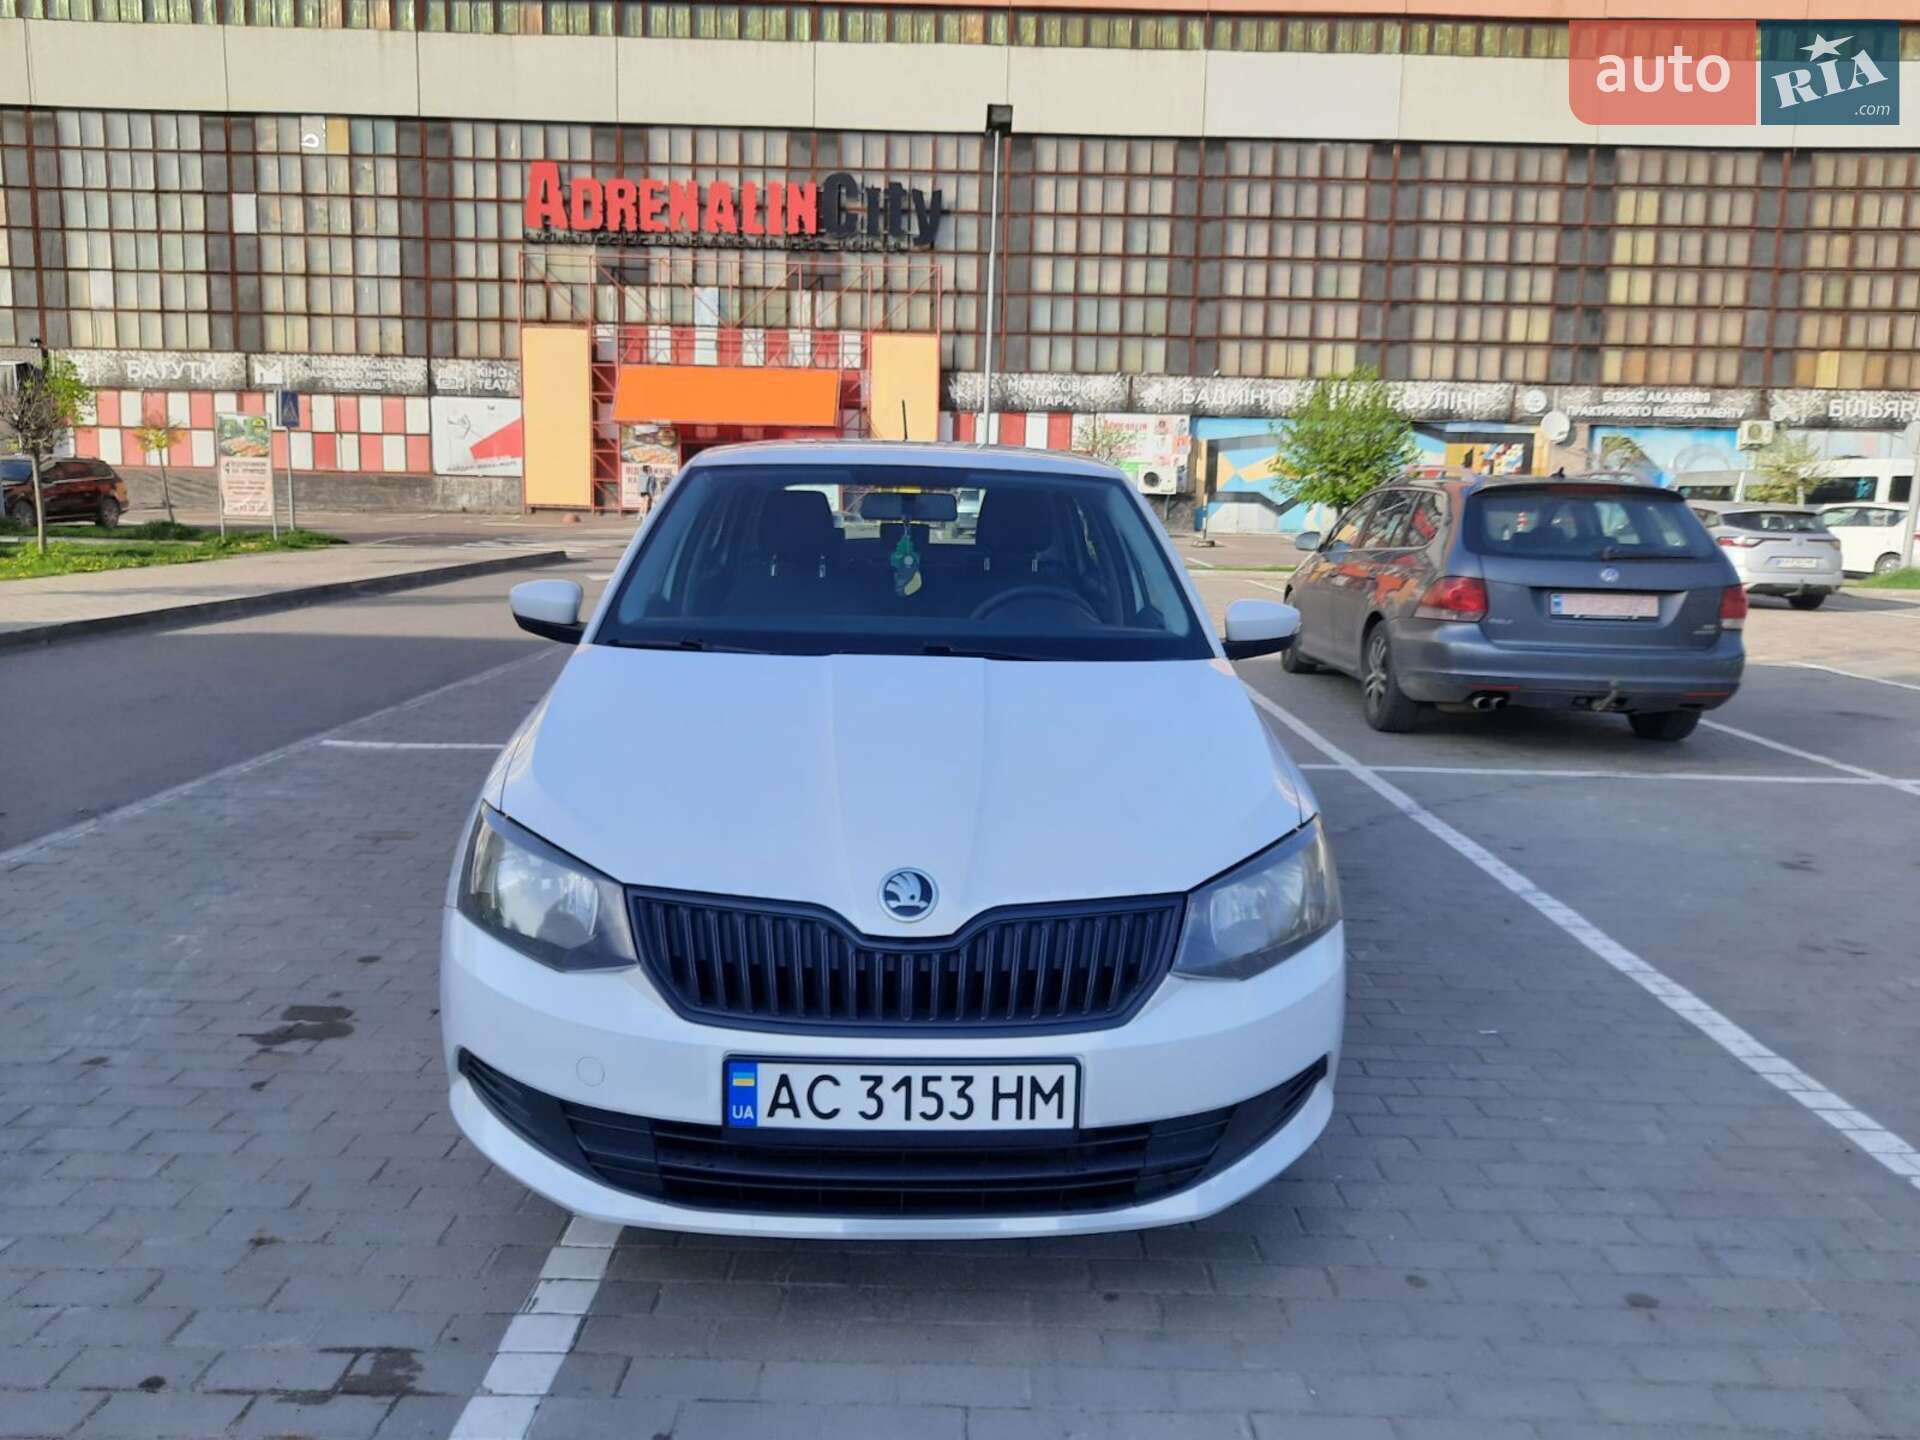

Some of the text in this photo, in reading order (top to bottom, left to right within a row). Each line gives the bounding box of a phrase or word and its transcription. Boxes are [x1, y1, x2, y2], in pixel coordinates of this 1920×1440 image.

[732, 1105, 755, 1121] UA
[766, 1073, 1066, 1122] AC 3153 HM
